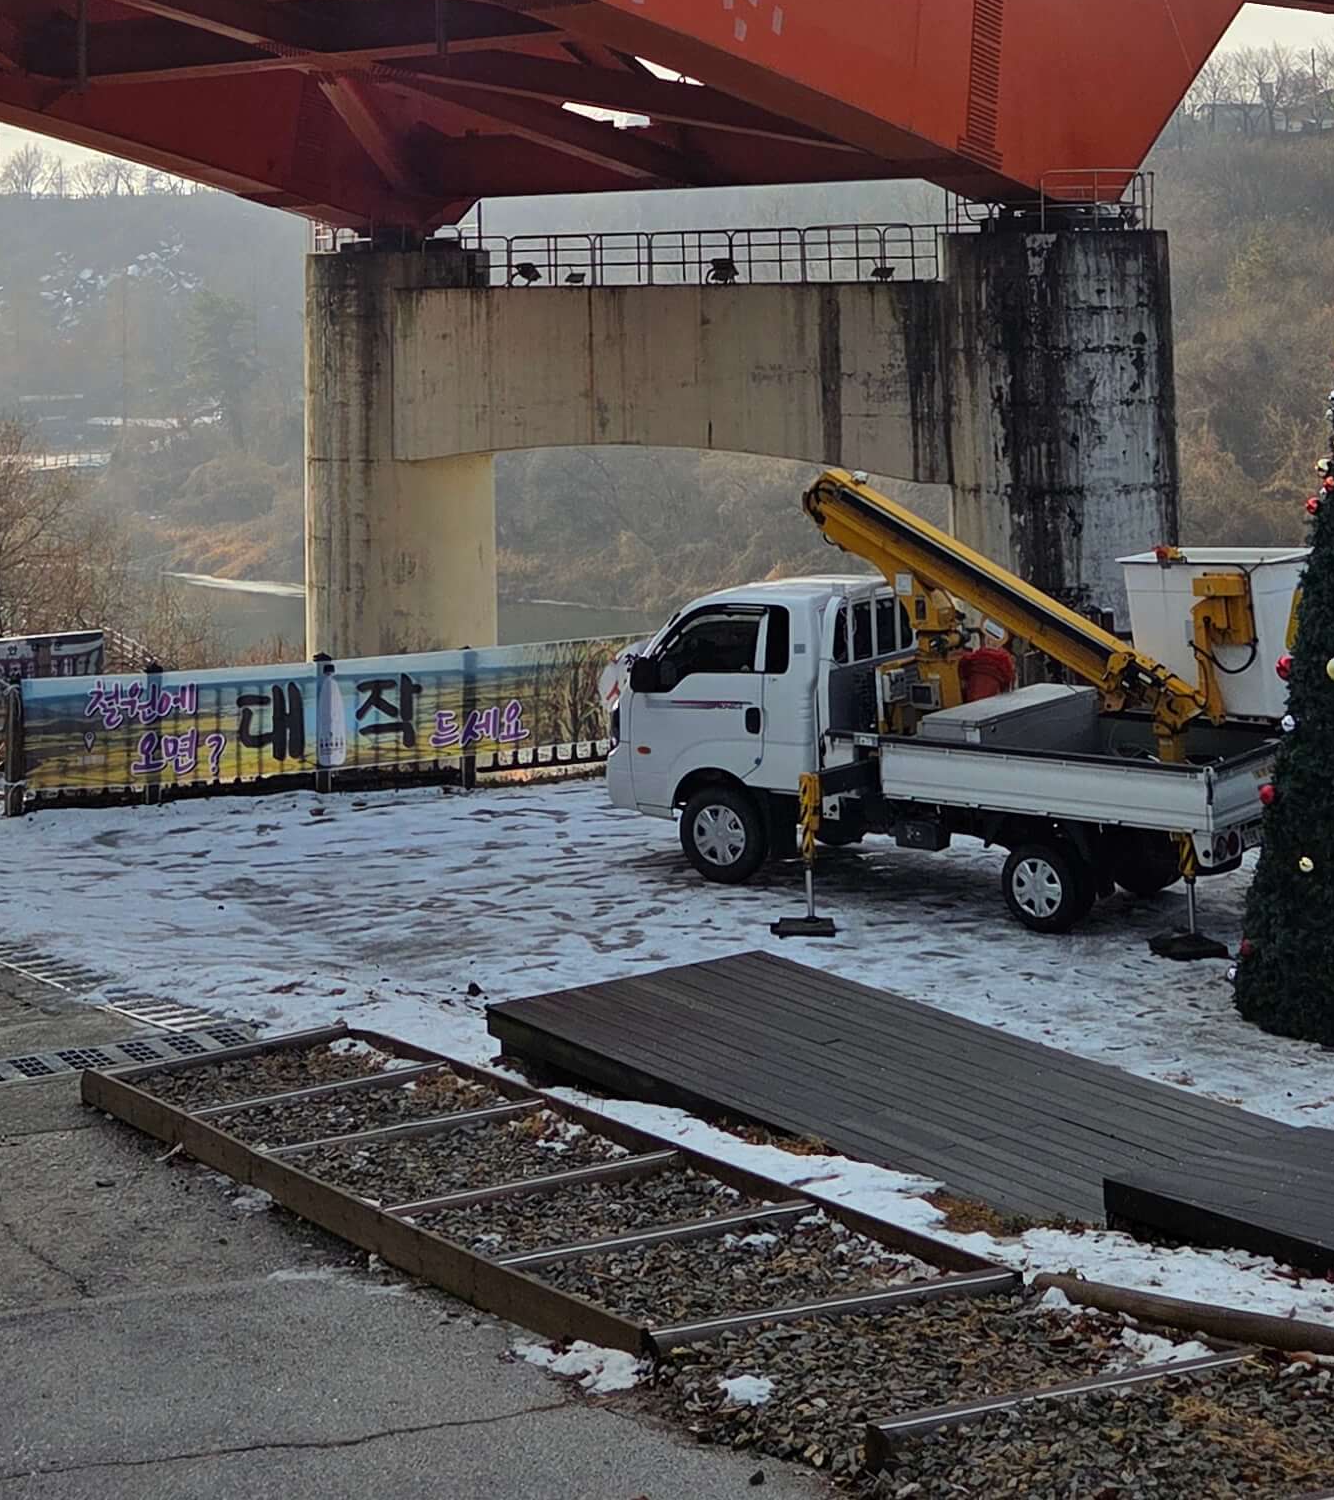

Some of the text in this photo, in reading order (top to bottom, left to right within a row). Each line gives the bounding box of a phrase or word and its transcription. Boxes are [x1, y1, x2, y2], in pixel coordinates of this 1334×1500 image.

[85, 679, 198, 729] 철원에
[236, 672, 423, 762] 대 작
[429, 700, 530, 747] 드세요
